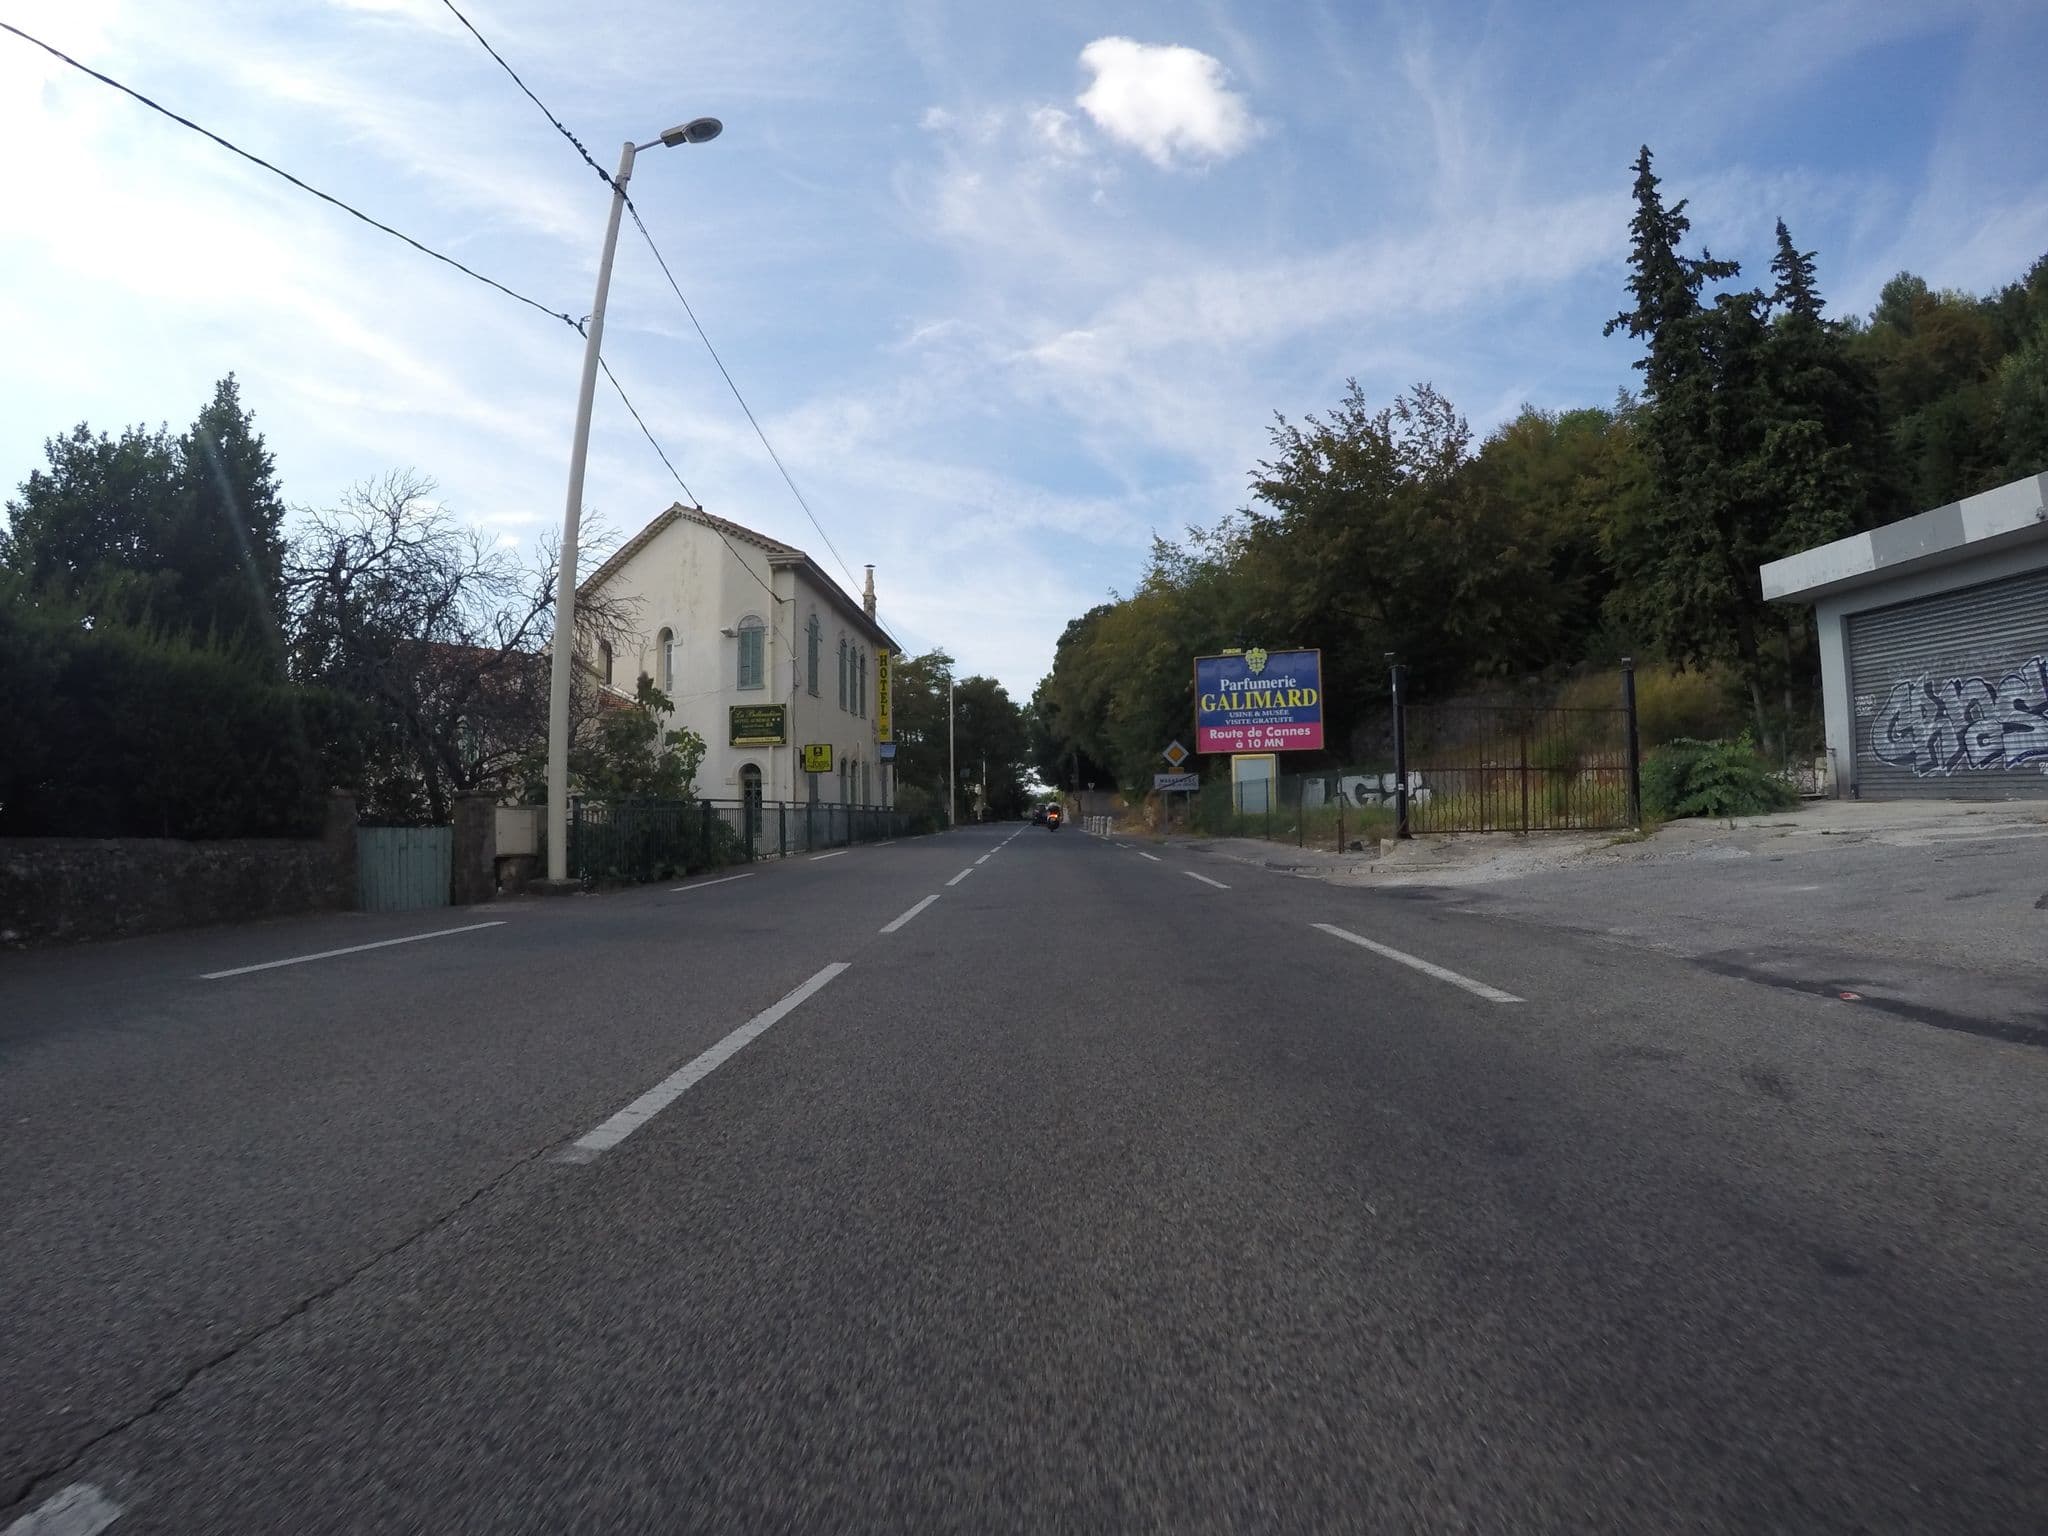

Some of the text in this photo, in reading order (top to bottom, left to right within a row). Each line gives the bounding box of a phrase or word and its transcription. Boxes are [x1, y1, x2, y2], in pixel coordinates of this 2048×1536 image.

[879, 654, 888, 717] HOTEL
[1220, 675, 1297, 691] Parfumerie
[1201, 688, 1318, 712] GALIMARD
[1261, 709, 1289, 717] MUSÉE
[1252, 716, 1294, 724] GRATUITE
[1209, 726, 1311, 739] Route de Cannes
[1235, 738, 1284, 749] à 10 MN
